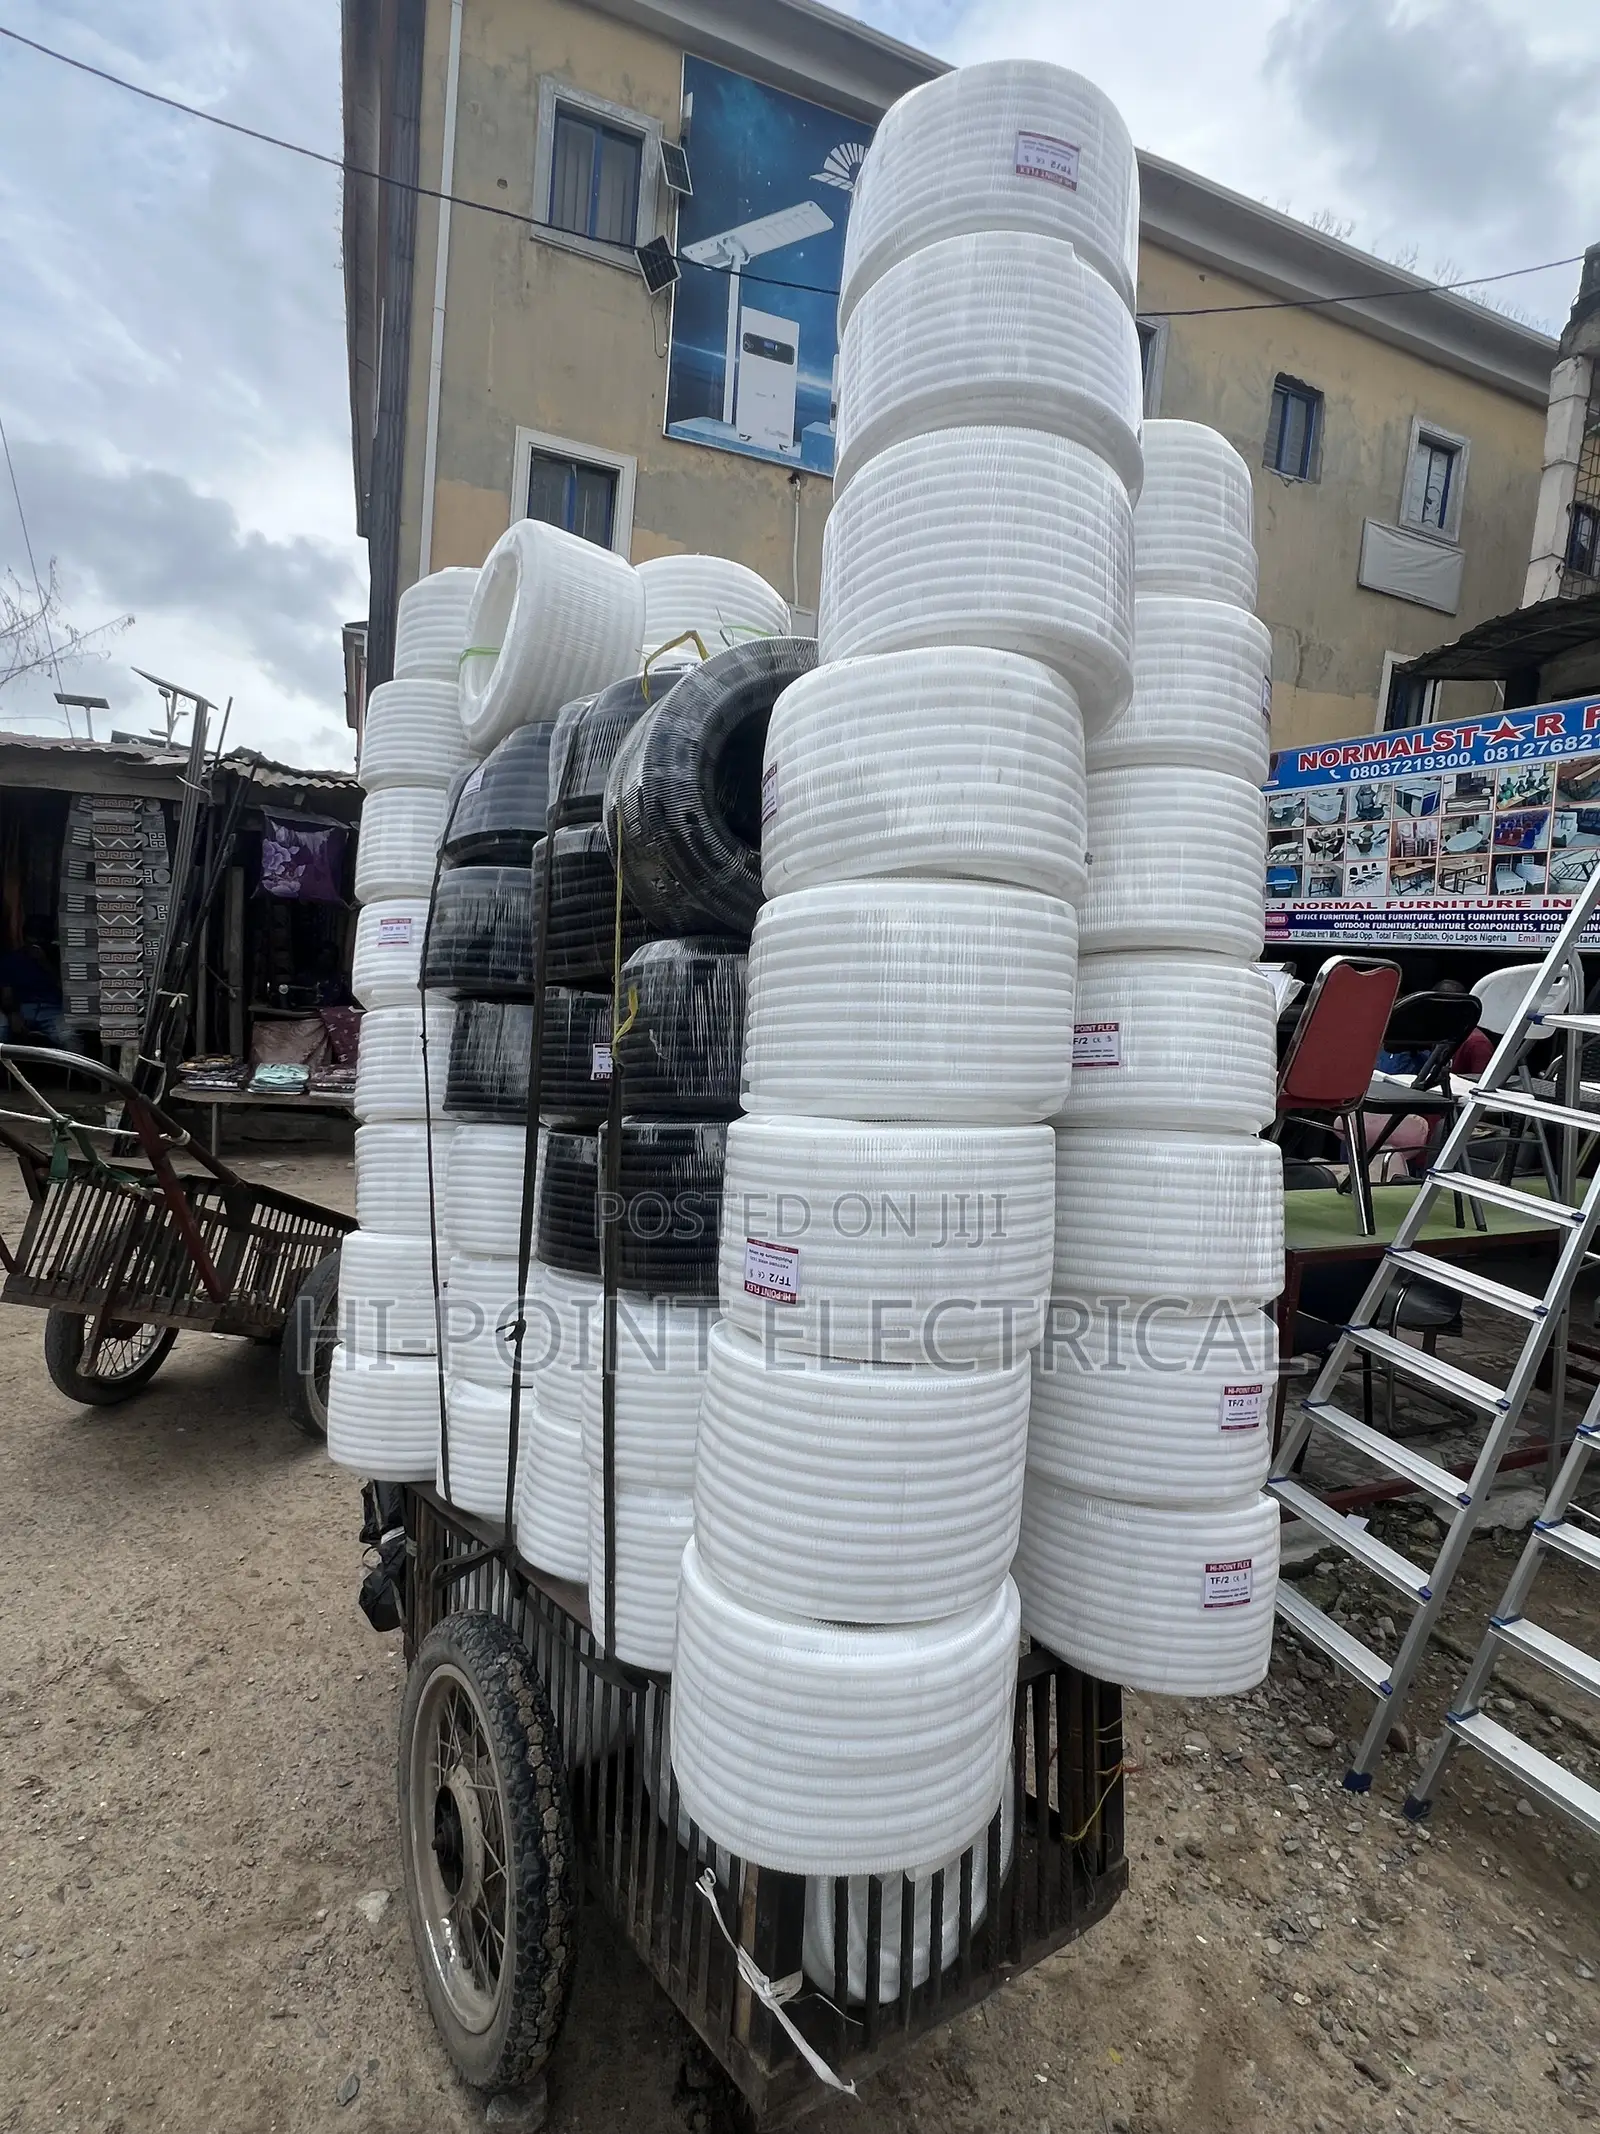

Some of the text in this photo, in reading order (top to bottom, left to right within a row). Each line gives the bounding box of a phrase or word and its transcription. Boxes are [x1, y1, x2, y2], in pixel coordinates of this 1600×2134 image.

[1350, 752, 1476, 780] 08037219300,
[1292, 901, 1378, 910] NORMAL
[1385, 900, 1532, 909] FURNITURE
[1296, 913, 1318, 921] OFFICE
[1363, 913, 1387, 921] HOME
[1388, 913, 1436, 921] FURNITURE,
[1438, 913, 1466, 921] HOTEL
[1467, 913, 1520, 921] FURNITURE
[1523, 913, 1564, 921] SCHOOL
[1468, 922, 1537, 931] COMPONENTS,
[1442, 932, 1454, 942] Ojo
[1456, 932, 1478, 943] Lagos
[1480, 933, 1507, 943] Nigeria
[769, 1272, 791, 1287] TF/2
[745, 1282, 791, 1302] HI-POINT FLEX
[1228, 1399, 1244, 1407] TF/2
[1210, 1575, 1230, 1585] TF/2
